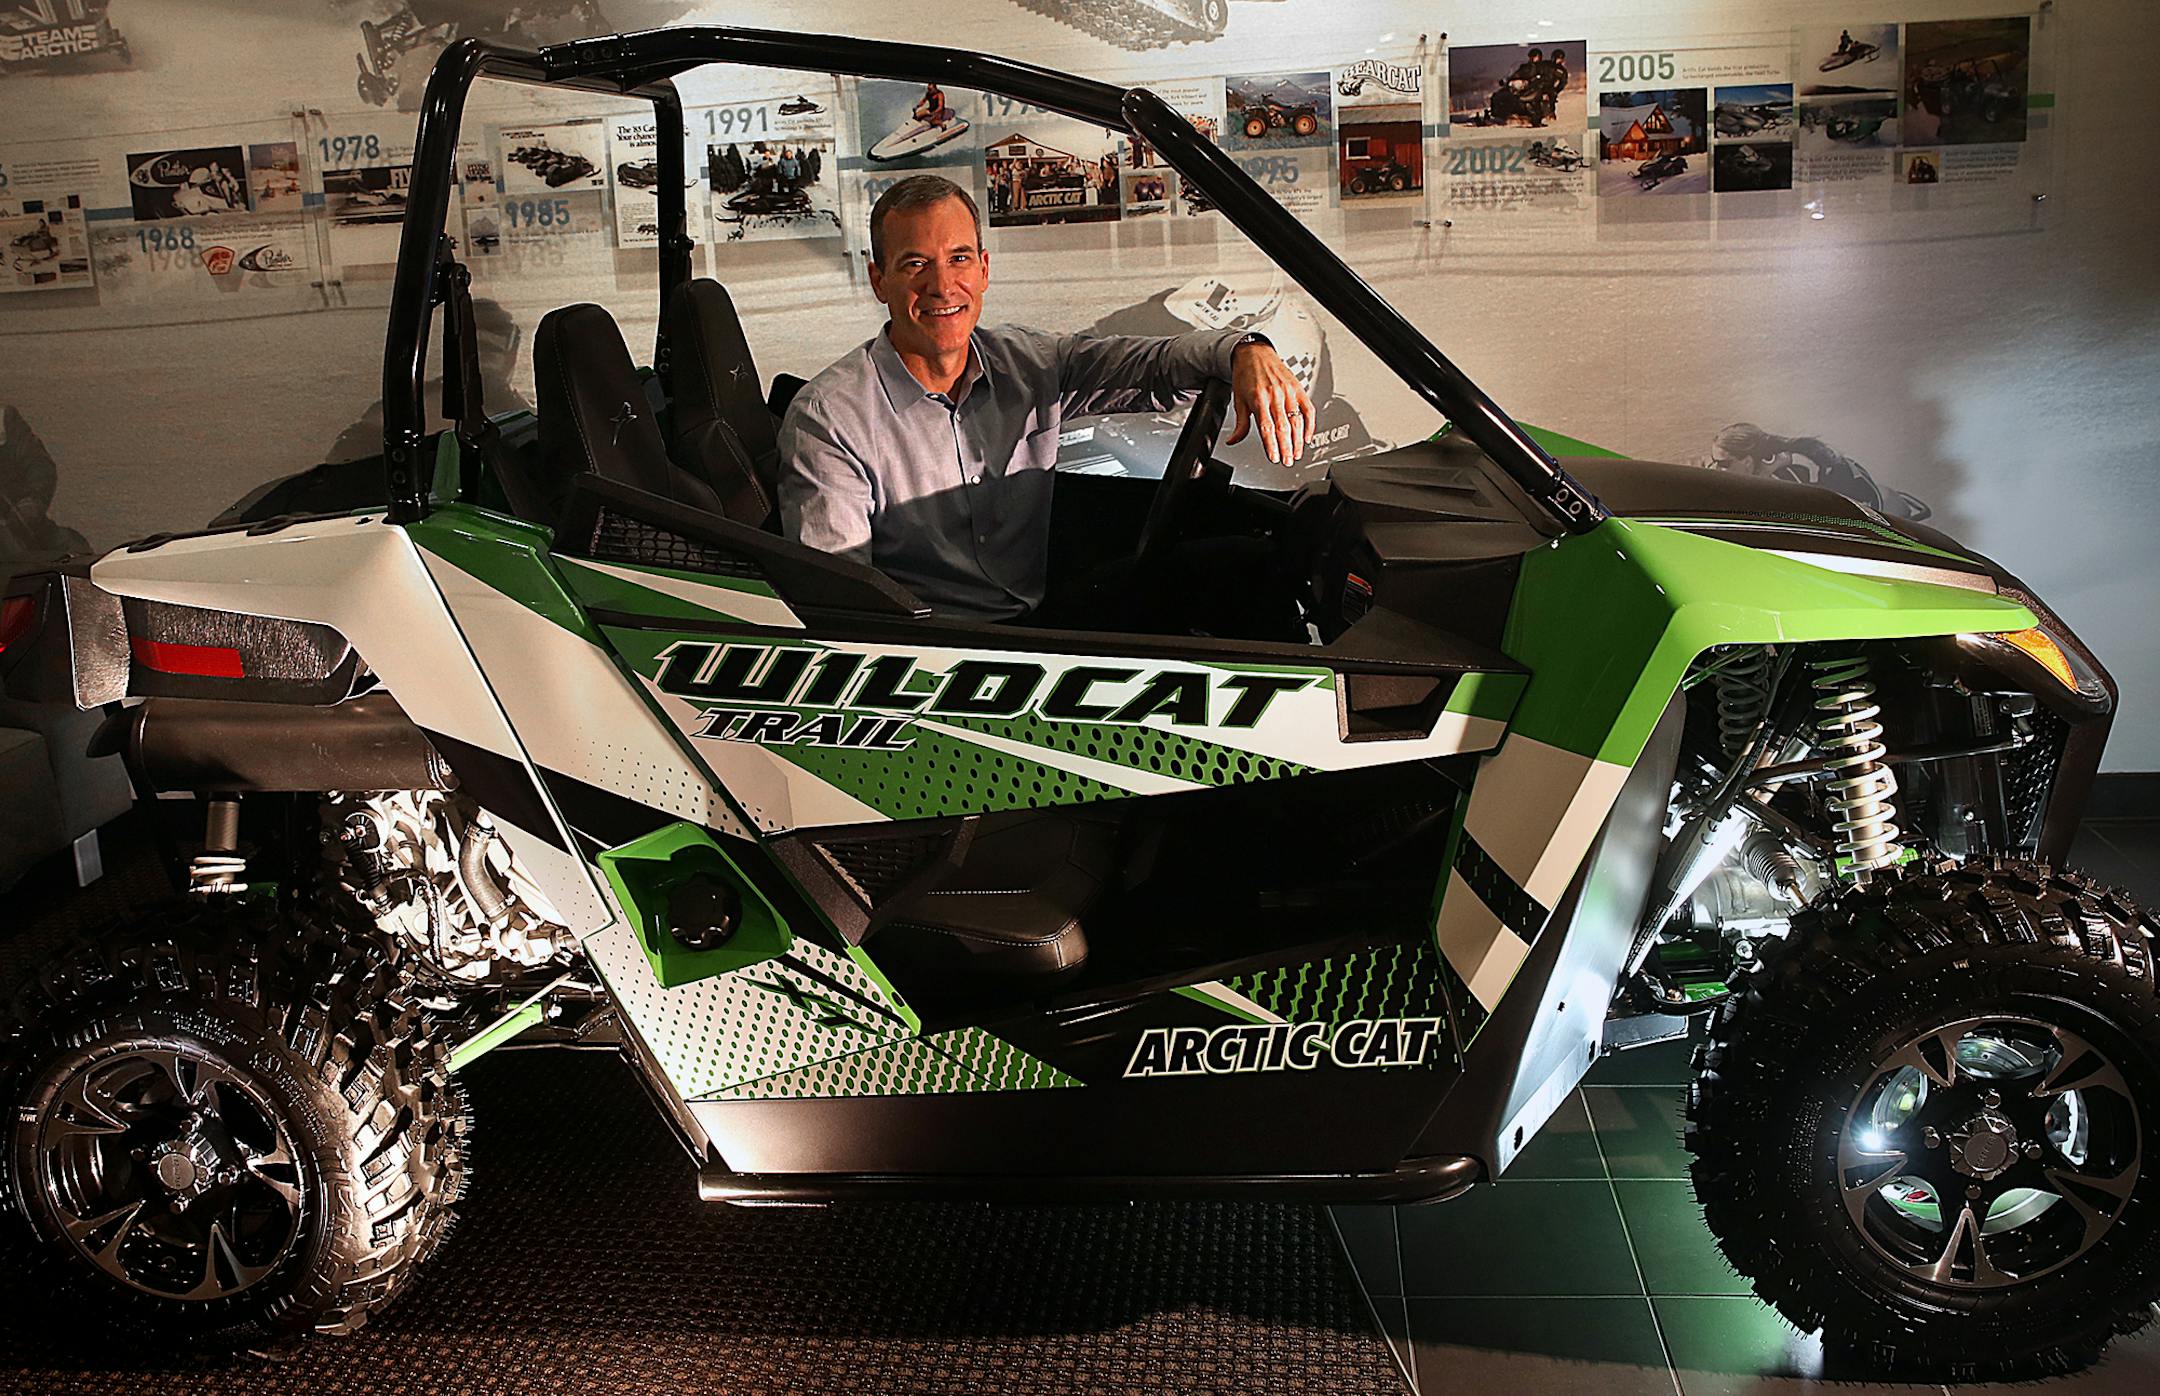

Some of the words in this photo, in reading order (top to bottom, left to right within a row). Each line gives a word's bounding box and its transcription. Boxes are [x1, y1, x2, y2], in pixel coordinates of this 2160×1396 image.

[20, 39, 92, 60] ARCTIC
[22, 26, 82, 46] TEAM
[1342, 59, 1421, 92] BEARCAT
[1599, 53, 1675, 83] 2005
[704, 107, 769, 135] 1991
[319, 134, 381, 162] 1978
[1449, 146, 1525, 175] 2002
[1028, 193, 1063, 206] ARCTIC
[1064, 191, 1084, 204] CAT
[506, 199, 571, 229] 1985
[135, 226, 195, 253] 1968
[655, 641, 1318, 729] WILDCAT
[692, 708, 921, 751] TRAIL
[1122, 1022, 1330, 1078] ARCTIC
[1326, 1016, 1443, 1068] CAT
